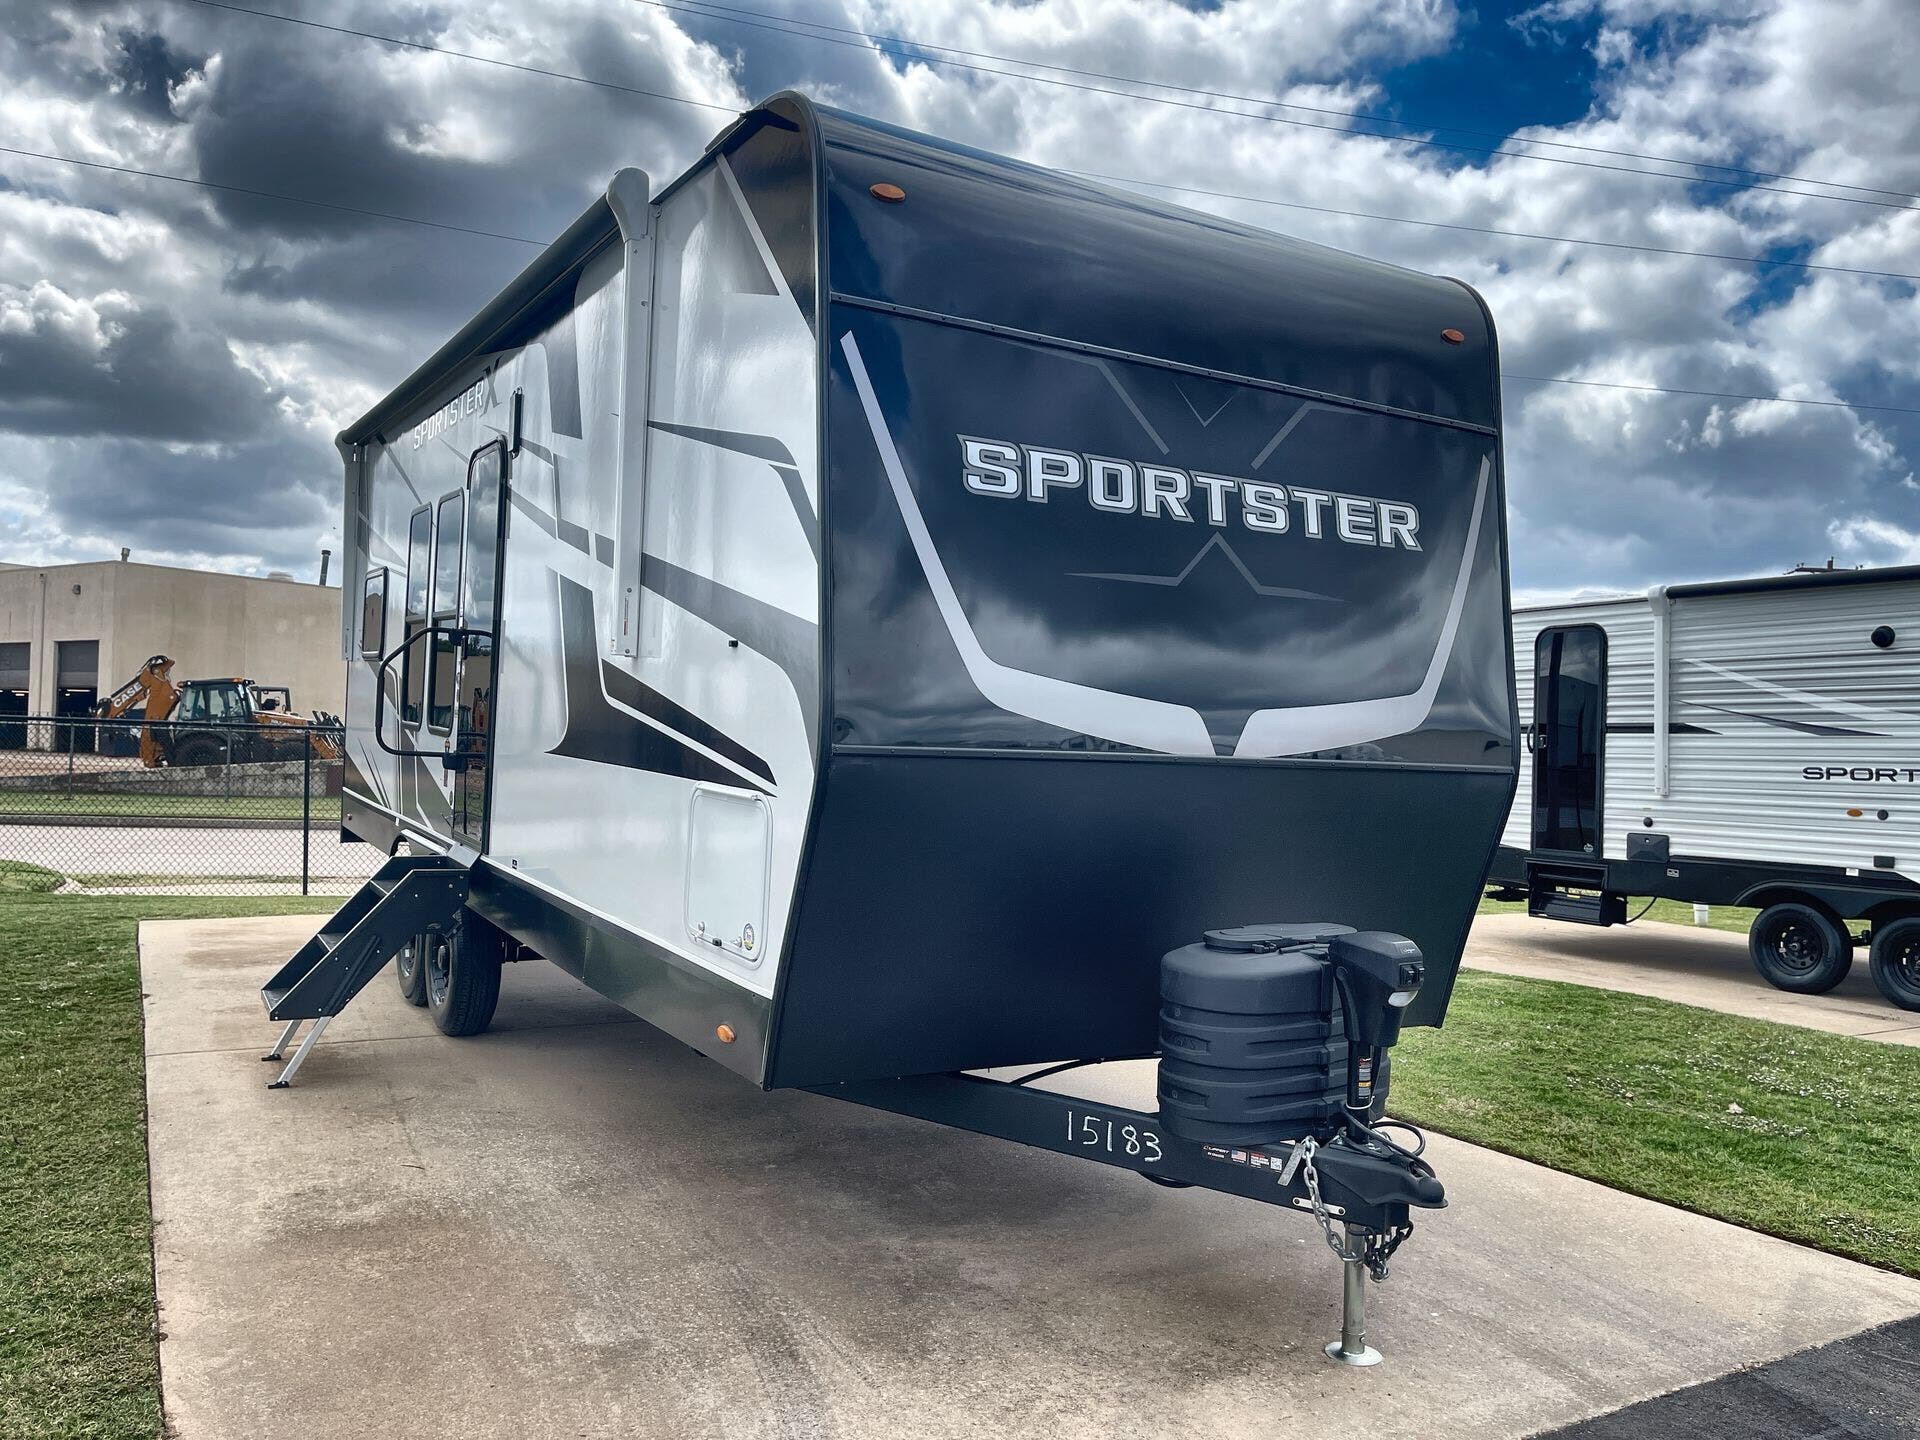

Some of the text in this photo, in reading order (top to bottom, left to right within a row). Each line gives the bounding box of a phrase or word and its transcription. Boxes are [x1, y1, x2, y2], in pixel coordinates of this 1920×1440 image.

[414, 381, 484, 450] SPORTSTER
[957, 434, 1422, 551] SPORTSTER
[113, 681, 143, 707] CASE
[1802, 766, 1920, 782] SPORT
[1067, 1110, 1162, 1162] 15183
